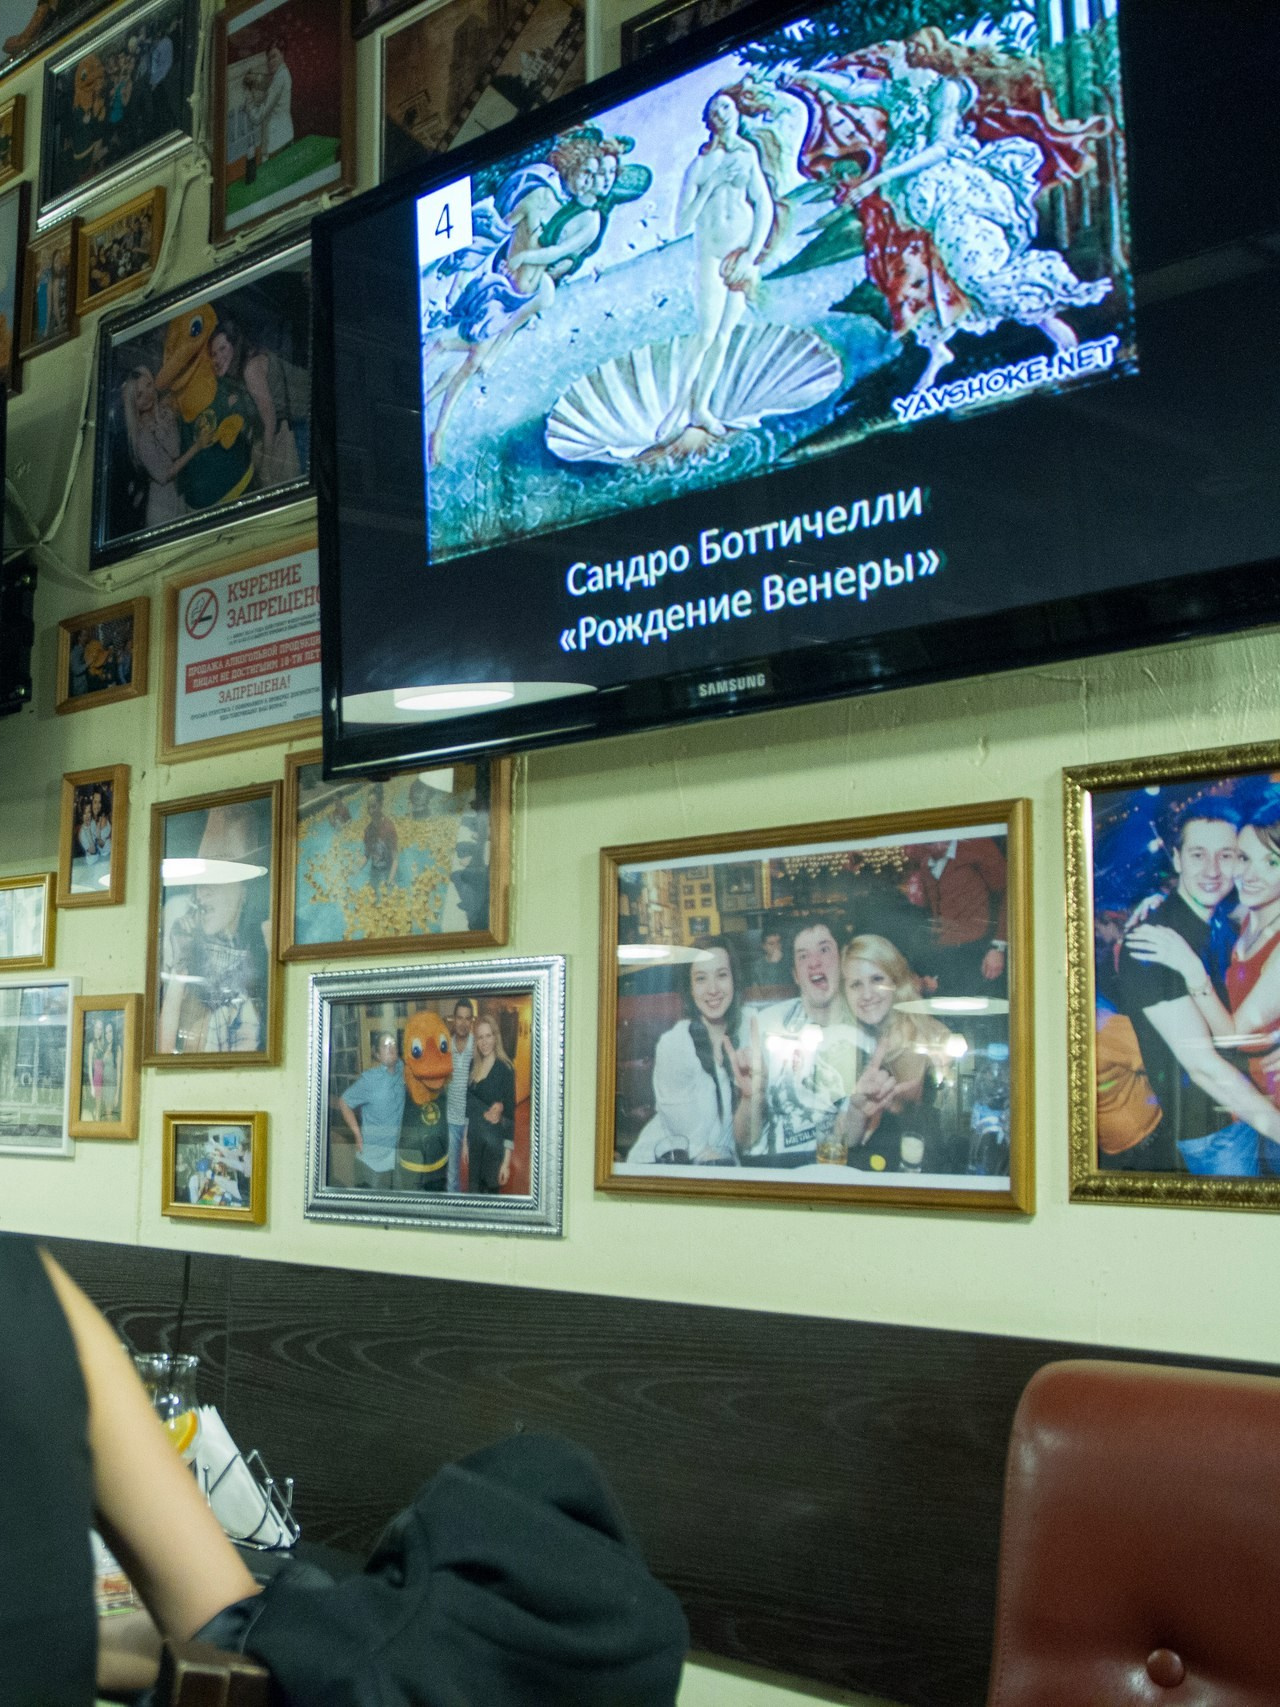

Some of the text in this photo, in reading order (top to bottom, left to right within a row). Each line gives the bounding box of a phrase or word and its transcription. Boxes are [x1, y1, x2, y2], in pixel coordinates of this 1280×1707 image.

[435, 203, 454, 239] 4
[893, 334, 1119, 423] YAVSHOKE.NET
[567, 486, 923, 597] Сандро Боттичелли
[226, 563, 302, 604] КУРЕНИЕ
[560, 548, 941, 653] «Рождение Венеры»
[219, 675, 291, 703] ЗАПРЕЩЕНА!
[698, 672, 766, 698] SAMSUNG
